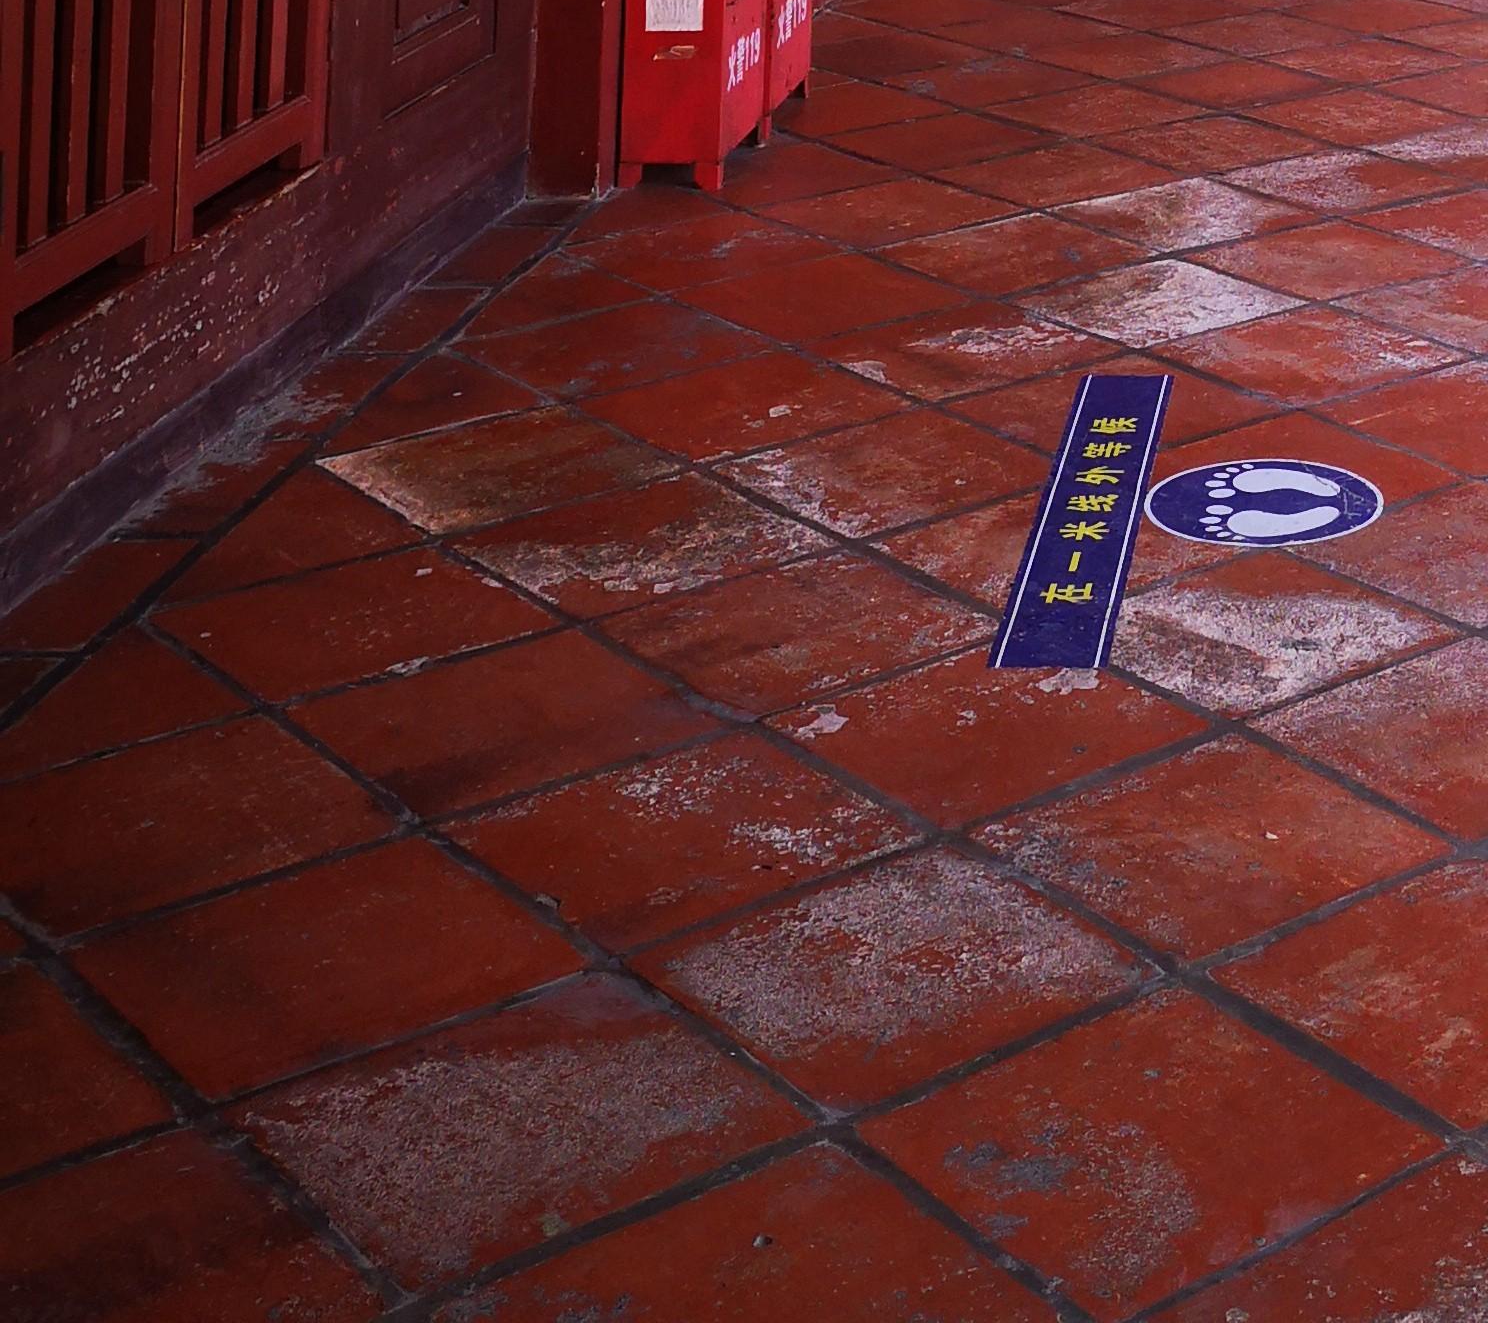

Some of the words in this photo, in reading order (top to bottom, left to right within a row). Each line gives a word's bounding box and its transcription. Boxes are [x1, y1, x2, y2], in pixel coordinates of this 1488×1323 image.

[727, 27, 761, 92] 火警119
[1038, 416, 1140, 605] 在一米线外等候
